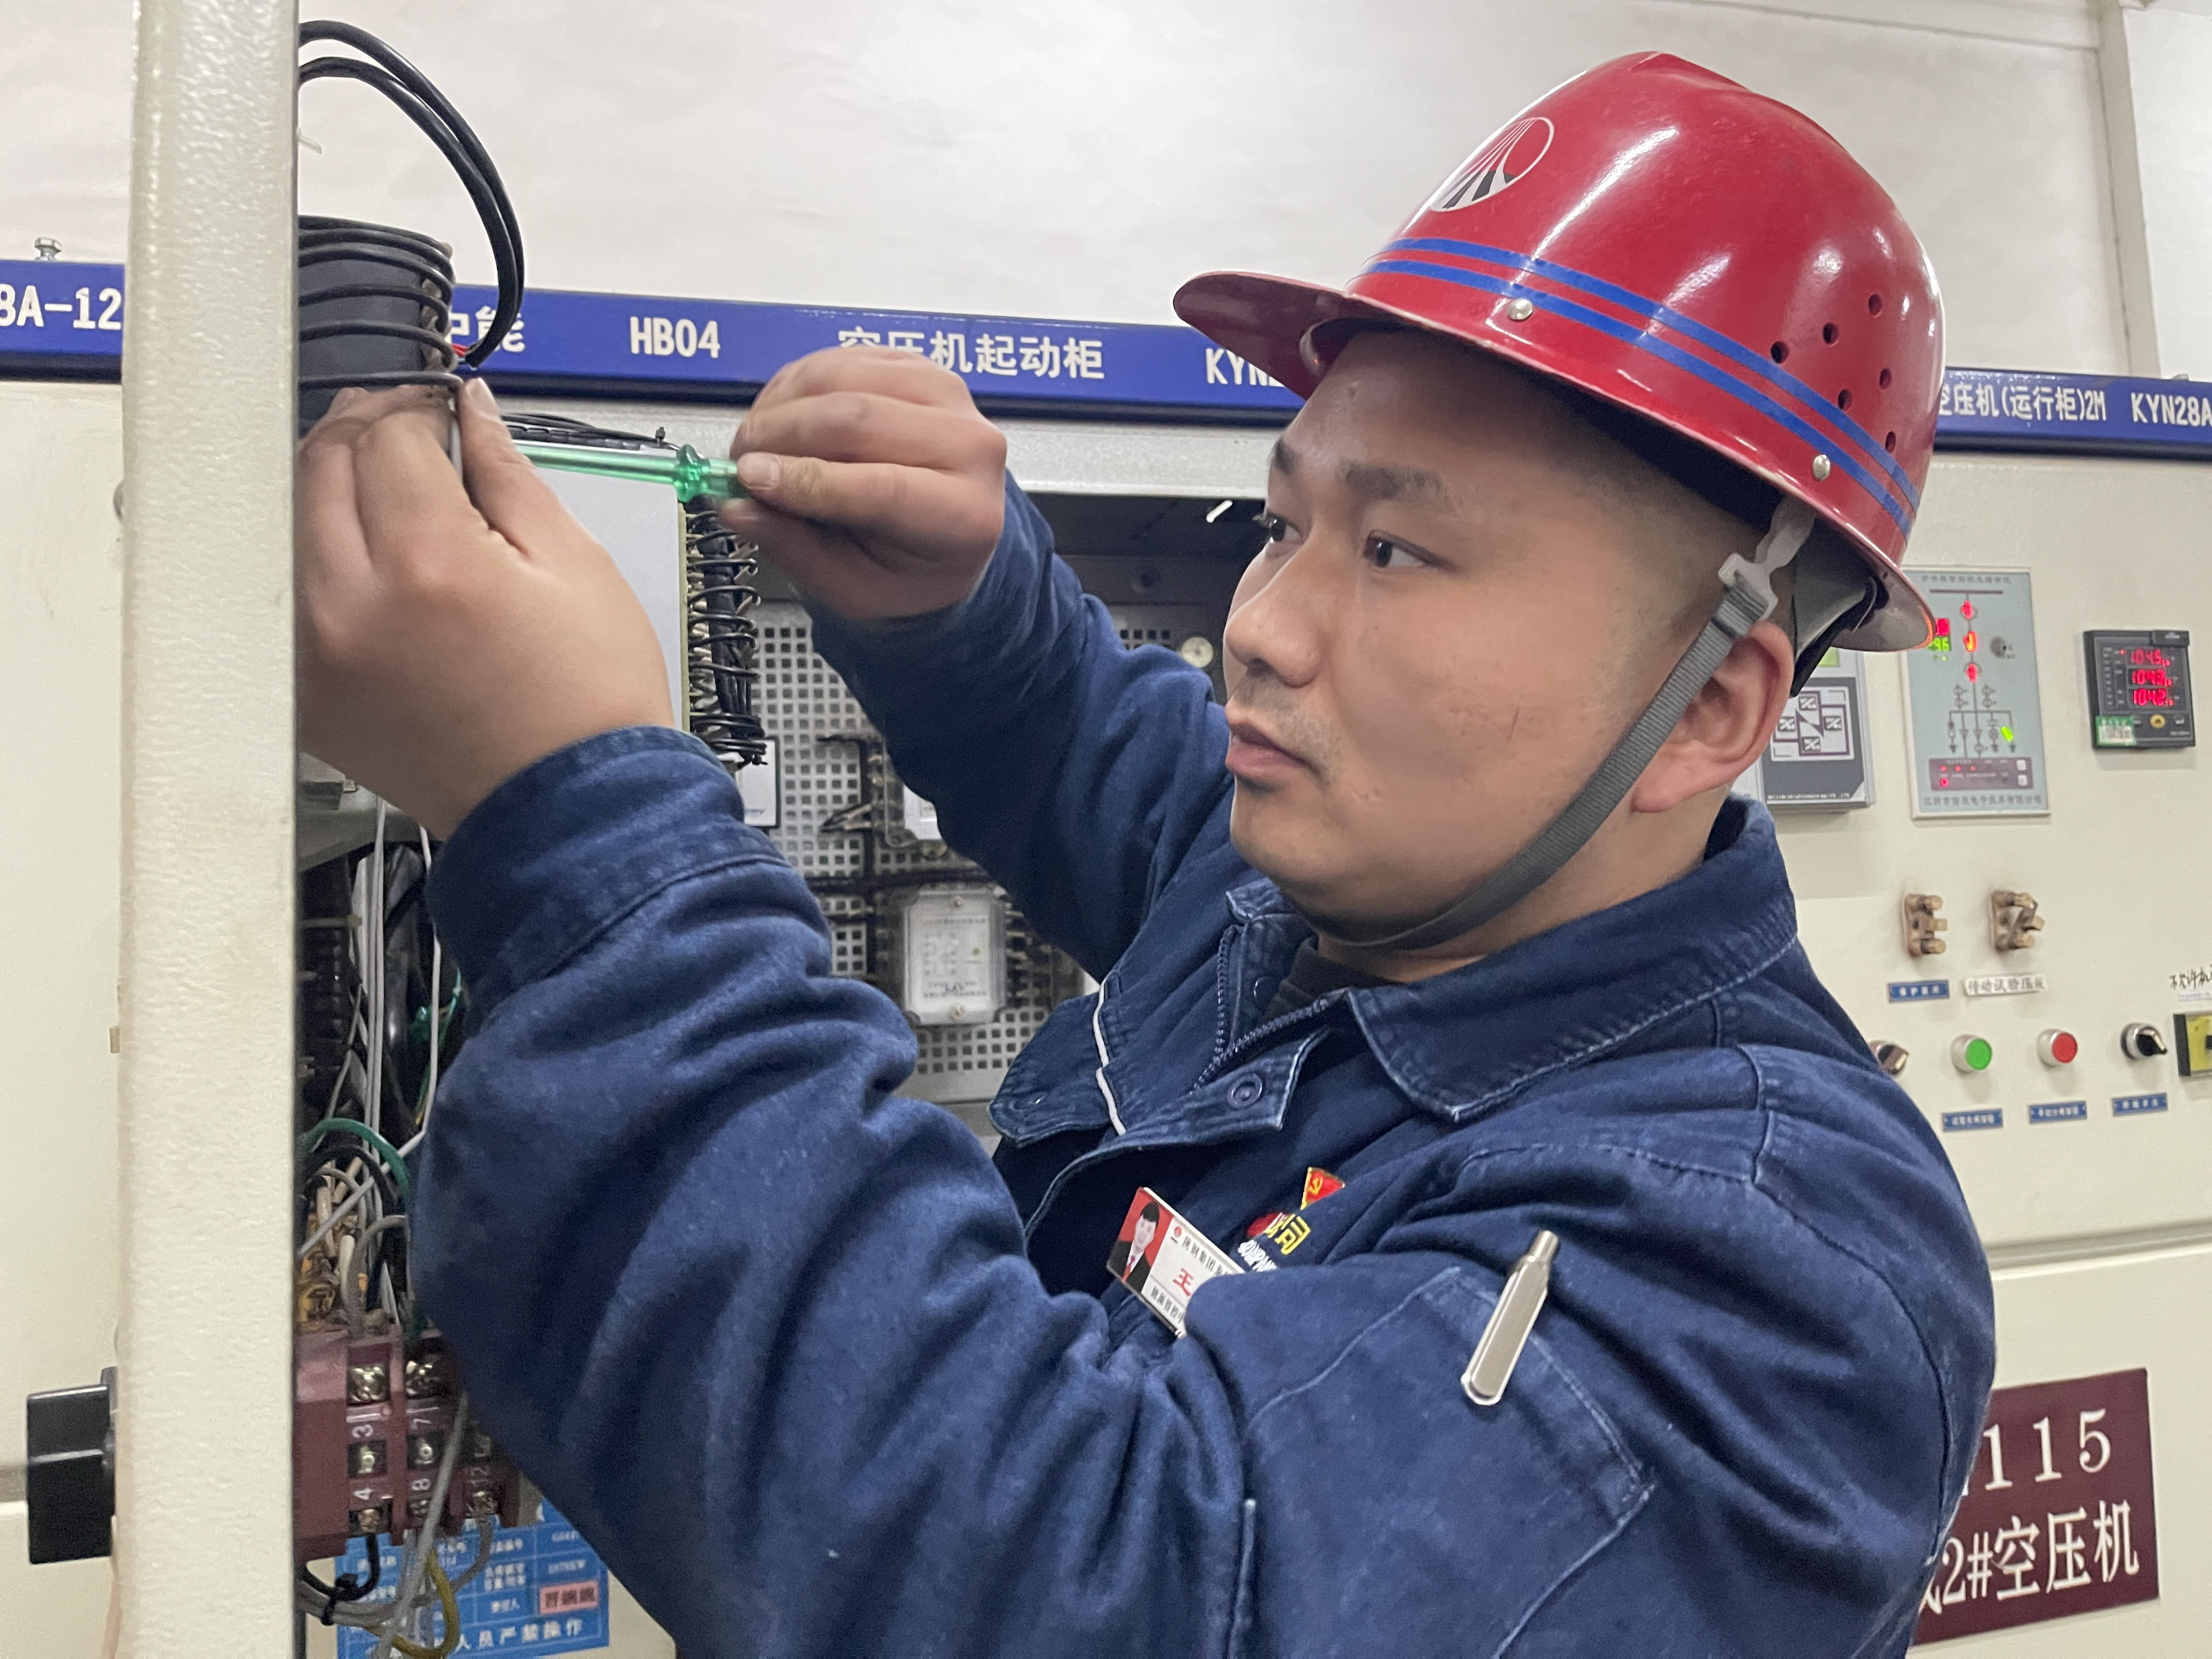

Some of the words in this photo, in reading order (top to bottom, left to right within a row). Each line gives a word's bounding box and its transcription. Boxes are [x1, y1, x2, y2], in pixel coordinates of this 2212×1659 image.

[630, 316, 721, 358] HB04
[1206, 348, 1285, 387] KYN
[352, 1424, 374, 1438] 3
[411, 1478, 431, 1491] 8
[353, 1487, 374, 1500] 4
